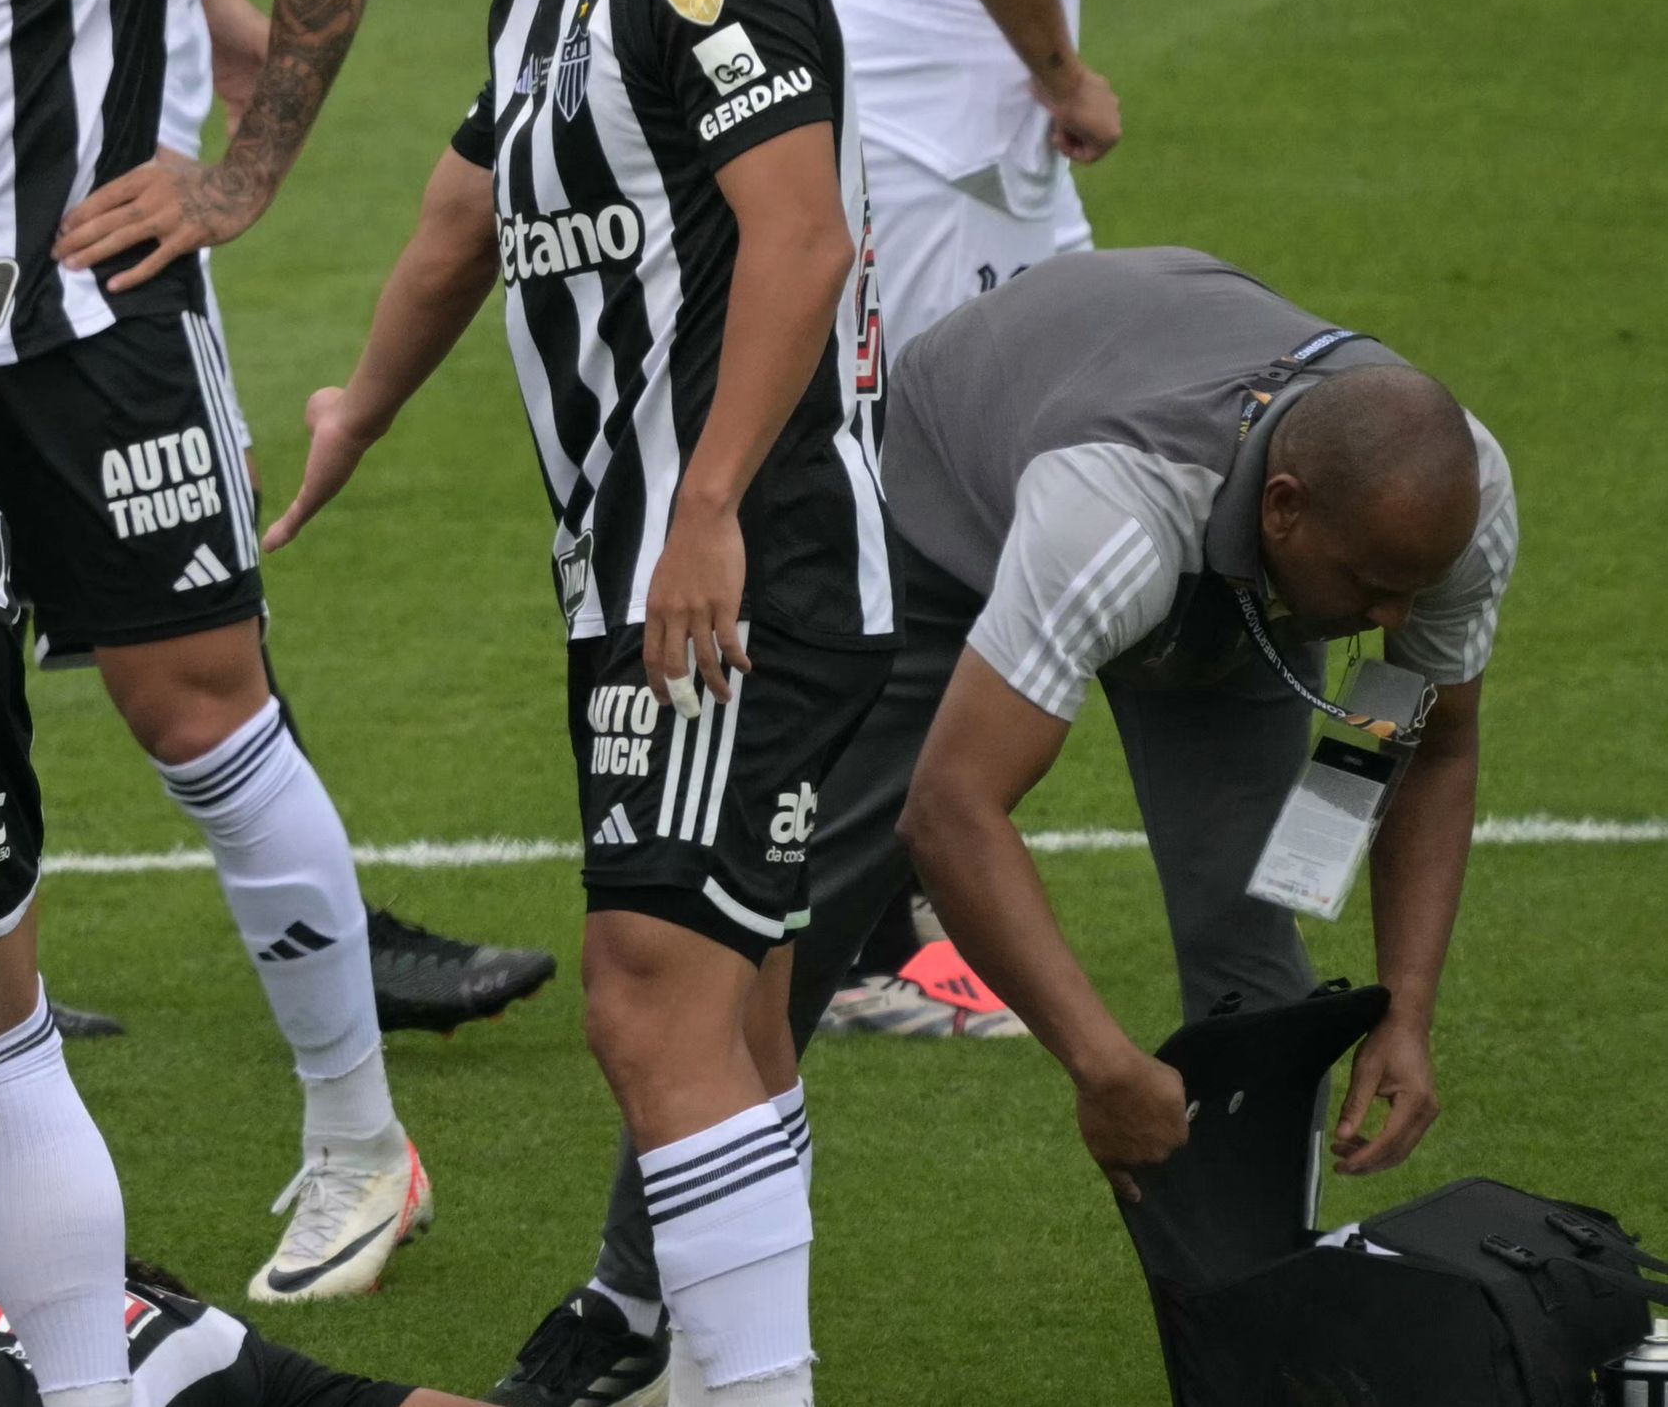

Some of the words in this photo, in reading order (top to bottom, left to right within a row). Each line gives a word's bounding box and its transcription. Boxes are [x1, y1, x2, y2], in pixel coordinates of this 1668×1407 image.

[699, 66, 813, 141] GERDAU
[497, 204, 642, 281] etano
[101, 426, 211, 499] AUTO
[107, 476, 222, 540] TRUCK
